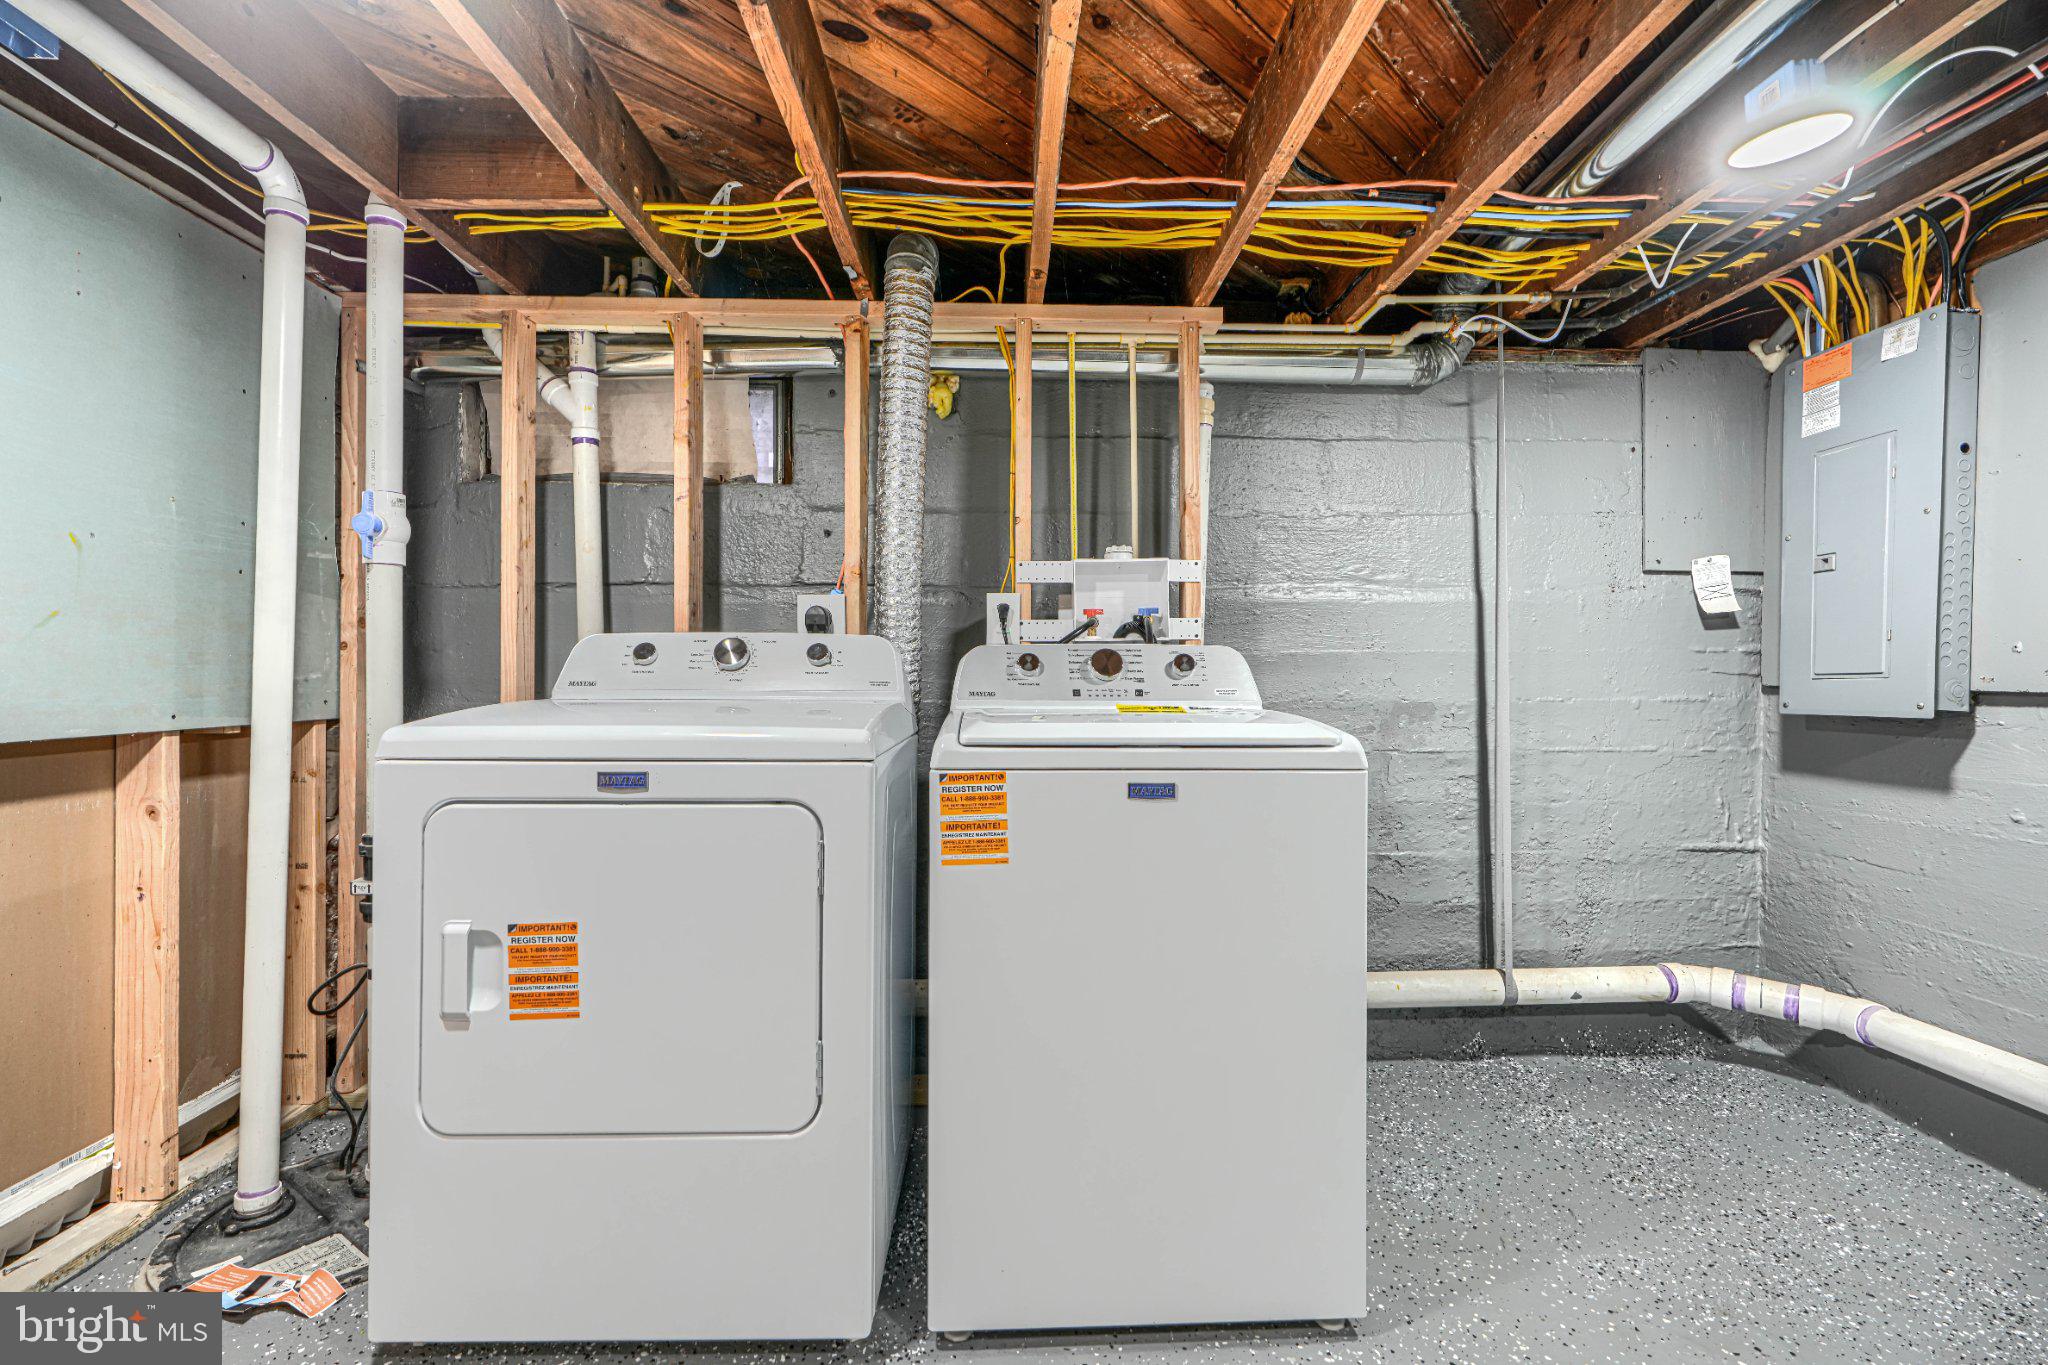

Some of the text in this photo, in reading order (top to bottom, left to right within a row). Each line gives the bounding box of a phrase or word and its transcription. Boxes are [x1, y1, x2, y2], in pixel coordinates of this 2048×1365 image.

[600, 775, 646, 785] MAYTAG
[948, 773, 998, 782] IMPORTANT!
[941, 784, 1004, 794] REGISTER NOW
[1131, 786, 1173, 796] MAYTAG
[945, 822, 1001, 831] IMPORTANTE!
[518, 924, 570, 933] IMPORTANT!
[511, 935, 576, 944] REGISTER NOW
[515, 974, 572, 983] IMPORTANTE!
